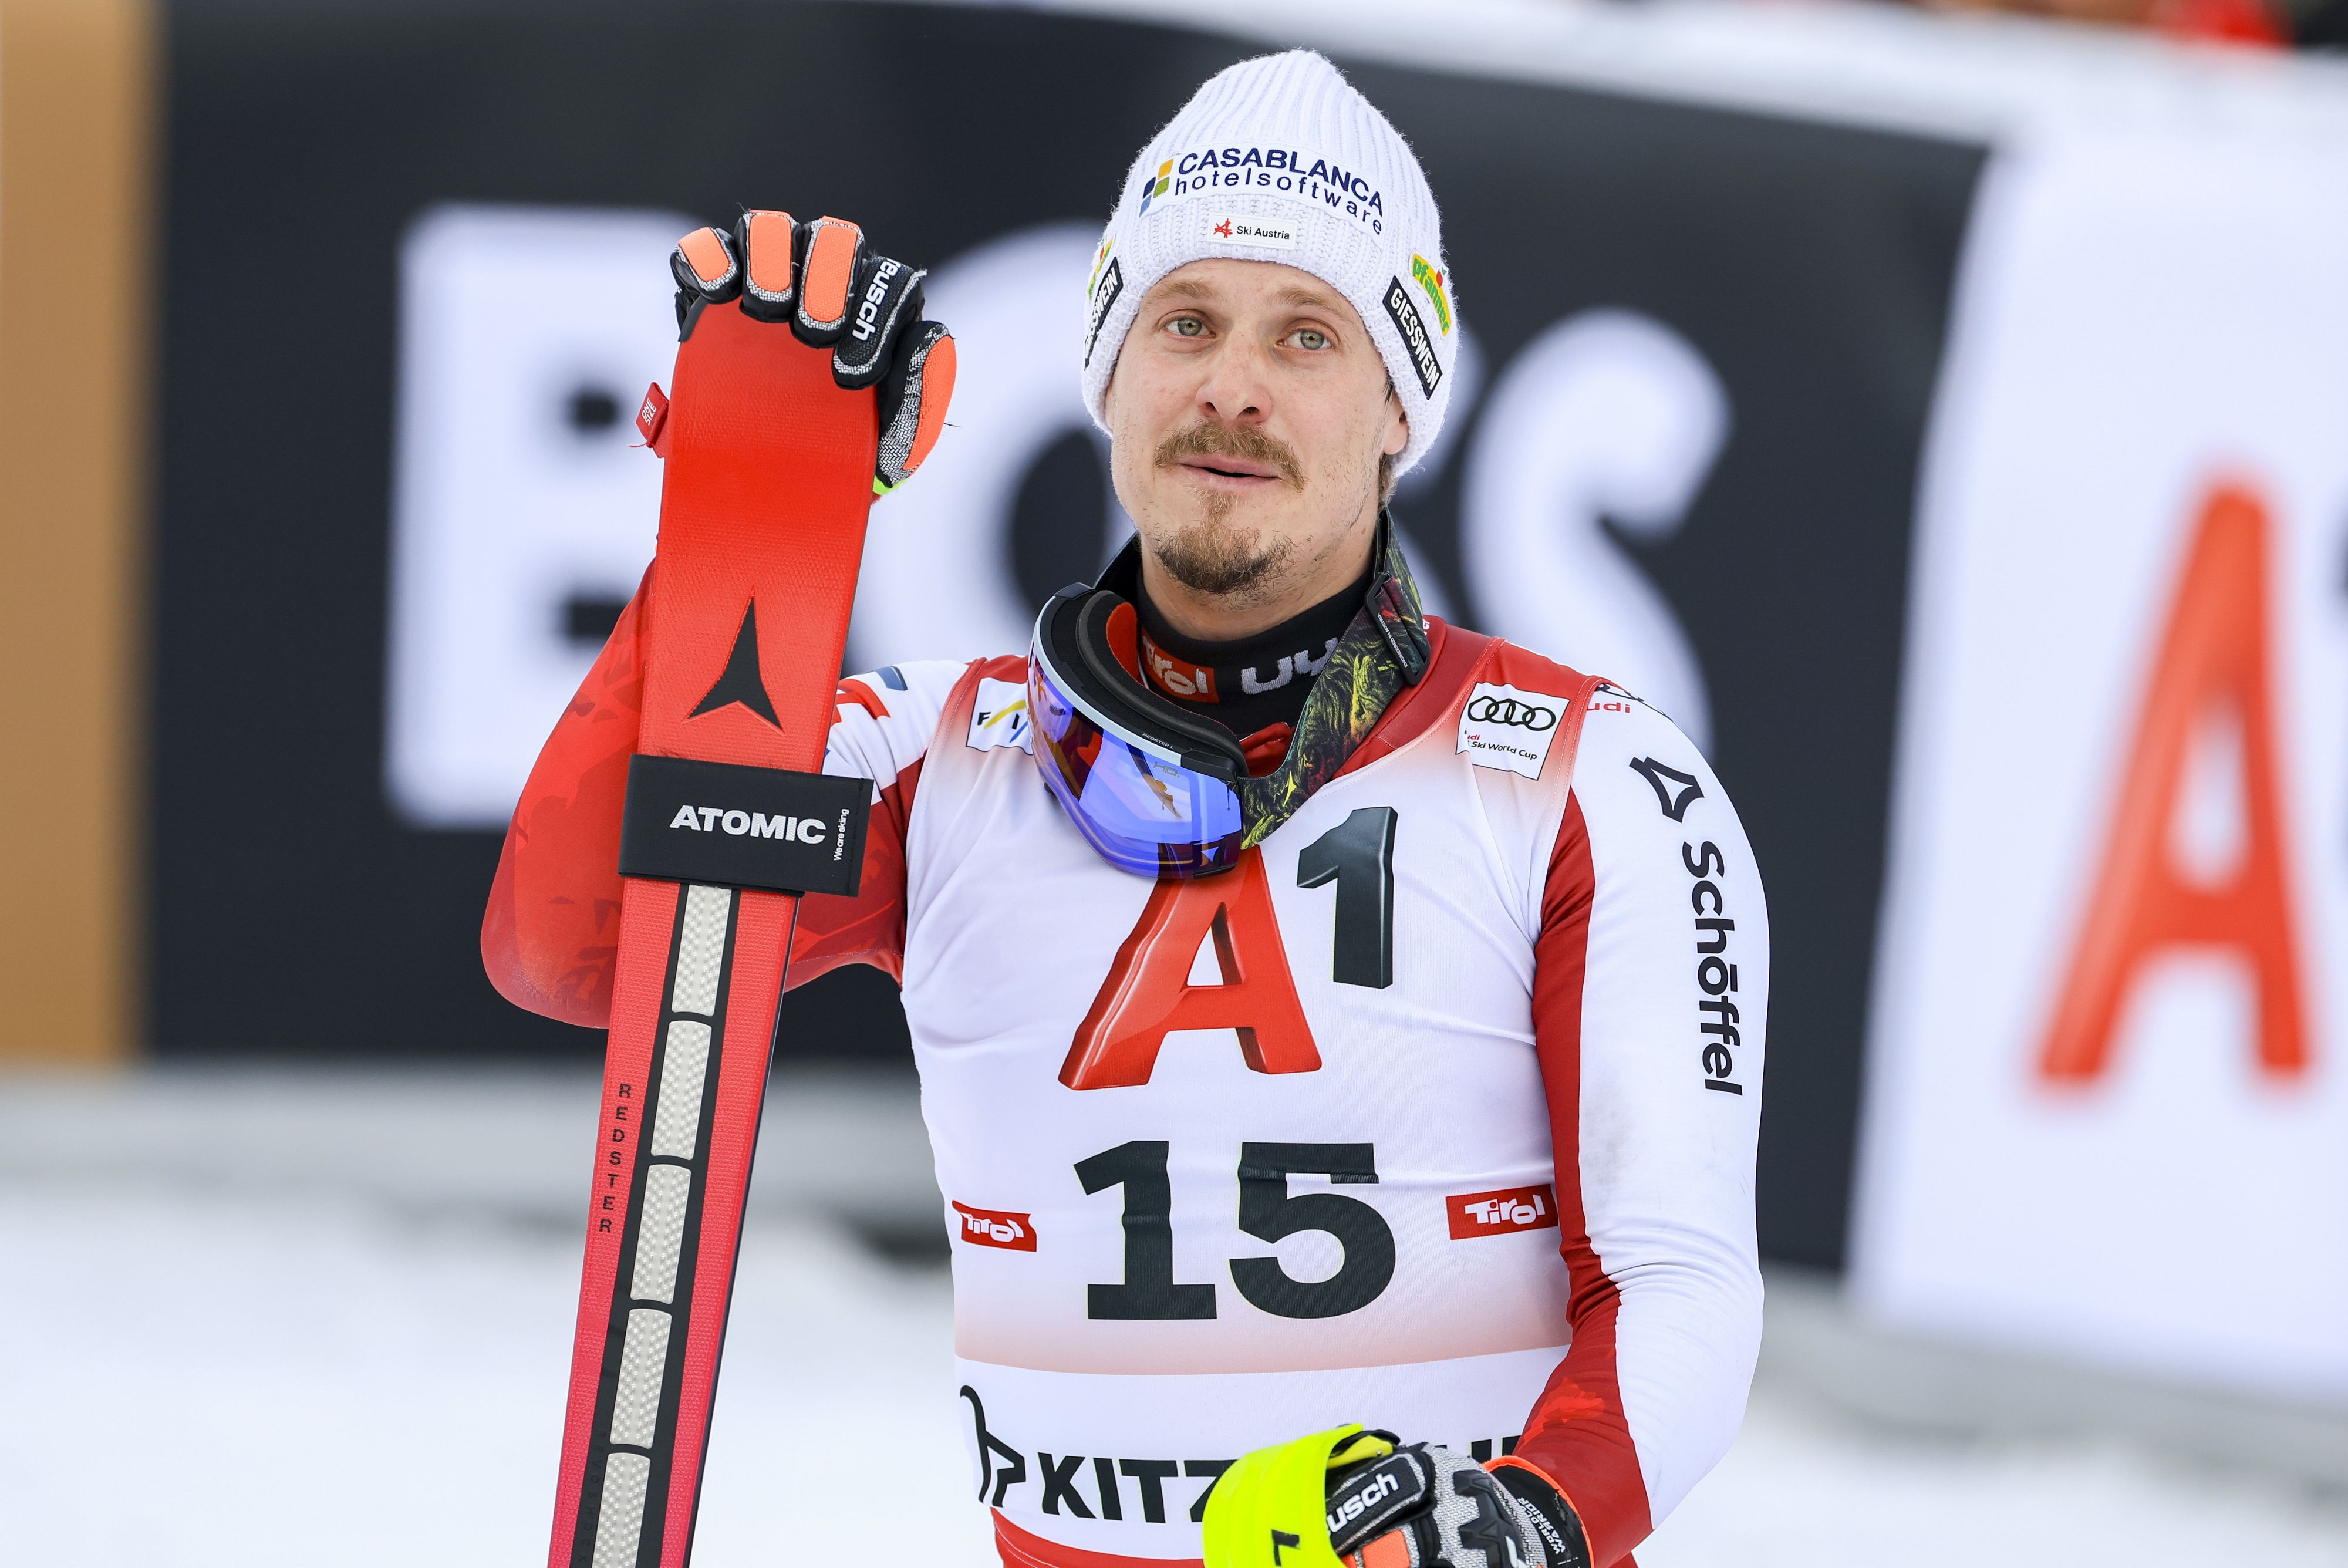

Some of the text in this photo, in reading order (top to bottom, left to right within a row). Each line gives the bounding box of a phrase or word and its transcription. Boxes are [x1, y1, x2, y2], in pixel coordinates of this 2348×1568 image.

[1175, 167, 1382, 235] hotelsoftware
[1178, 147, 1383, 218] CASABLANCA
[1236, 225, 1290, 240] Ski Austria
[1390, 288, 1440, 390] GIESSWEIN
[642, 397, 652, 420] ONE
[645, 403, 657, 426] SIZE
[384, 200, 1735, 834] BOS
[1377, 612, 1408, 669] ENGINEERED IN AUSTRIA
[977, 711, 1020, 730] FI
[1586, 702, 1630, 714] udi
[1142, 733, 1171, 747] REDSTER
[1488, 743, 1517, 754] World
[1519, 750, 1537, 760] Cup
[2031, 478, 2348, 1086] A
[669, 804, 826, 845] ATOMIC
[833, 847, 843, 861] We
[838, 808, 850, 833] skiing
[599, 1083, 632, 1233] REDSTER
[960, 1212, 1024, 1243] Tirol
[1464, 1193, 1546, 1225] Tirol
[1074, 1140, 1396, 1320] 15
